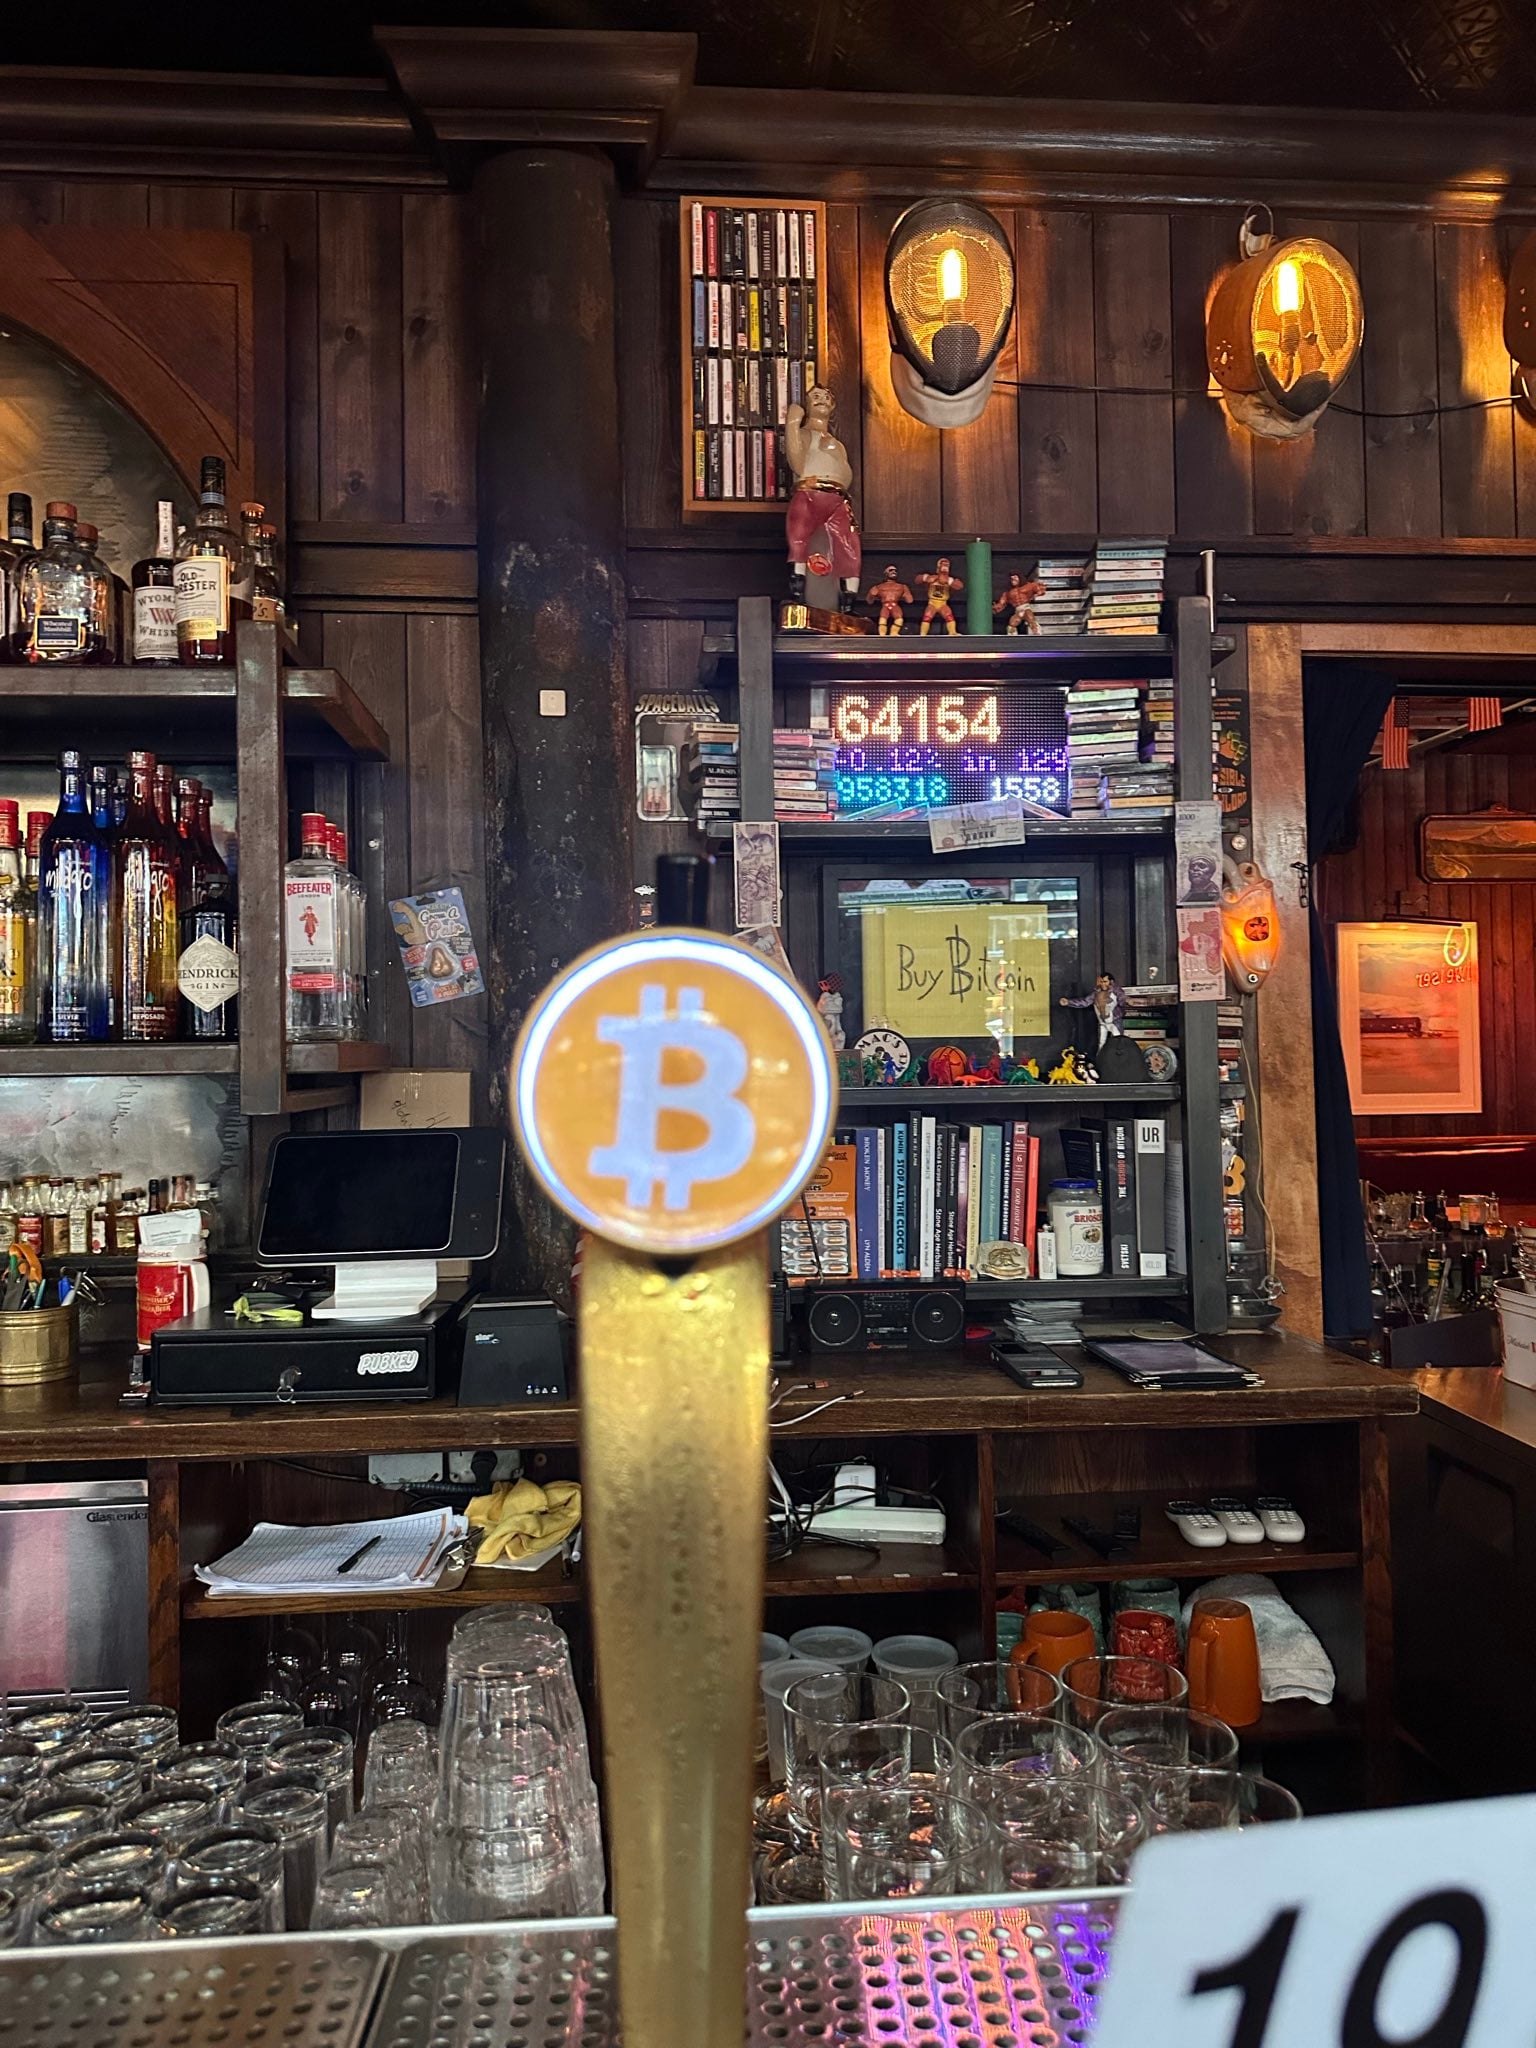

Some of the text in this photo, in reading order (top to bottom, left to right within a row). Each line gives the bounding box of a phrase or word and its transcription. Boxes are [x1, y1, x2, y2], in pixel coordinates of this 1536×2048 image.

[181, 572, 197, 583] OLD
[635, 694, 720, 714] SPACEBALLS
[838, 696, 1001, 742] 64154
[963, 749, 996, 771] in
[837, 776, 1060, 801] 958318 1558
[287, 882, 332, 896] BEEFEATER
[897, 942, 944, 1000] Buy
[858, 1034, 901, 1050] MAC'S
[1142, 1127, 1160, 1142] UR
[1116, 1126, 1127, 1198] THE BUSHIDO OF BITCOIN
[896, 1130, 905, 1255] KUMIN STOP ALL THE CLOCKS
[935, 1208, 943, 1228] Stone
[1002, 1200, 1010, 1234] REORDERING
[864, 1239, 872, 1250] LYN
[947, 1229, 955, 1240] Age
[864, 1252, 872, 1272] ALDEN
[1120, 1244, 1130, 1269] SVETSKI
[358, 1351, 418, 1374] PUBKEY
